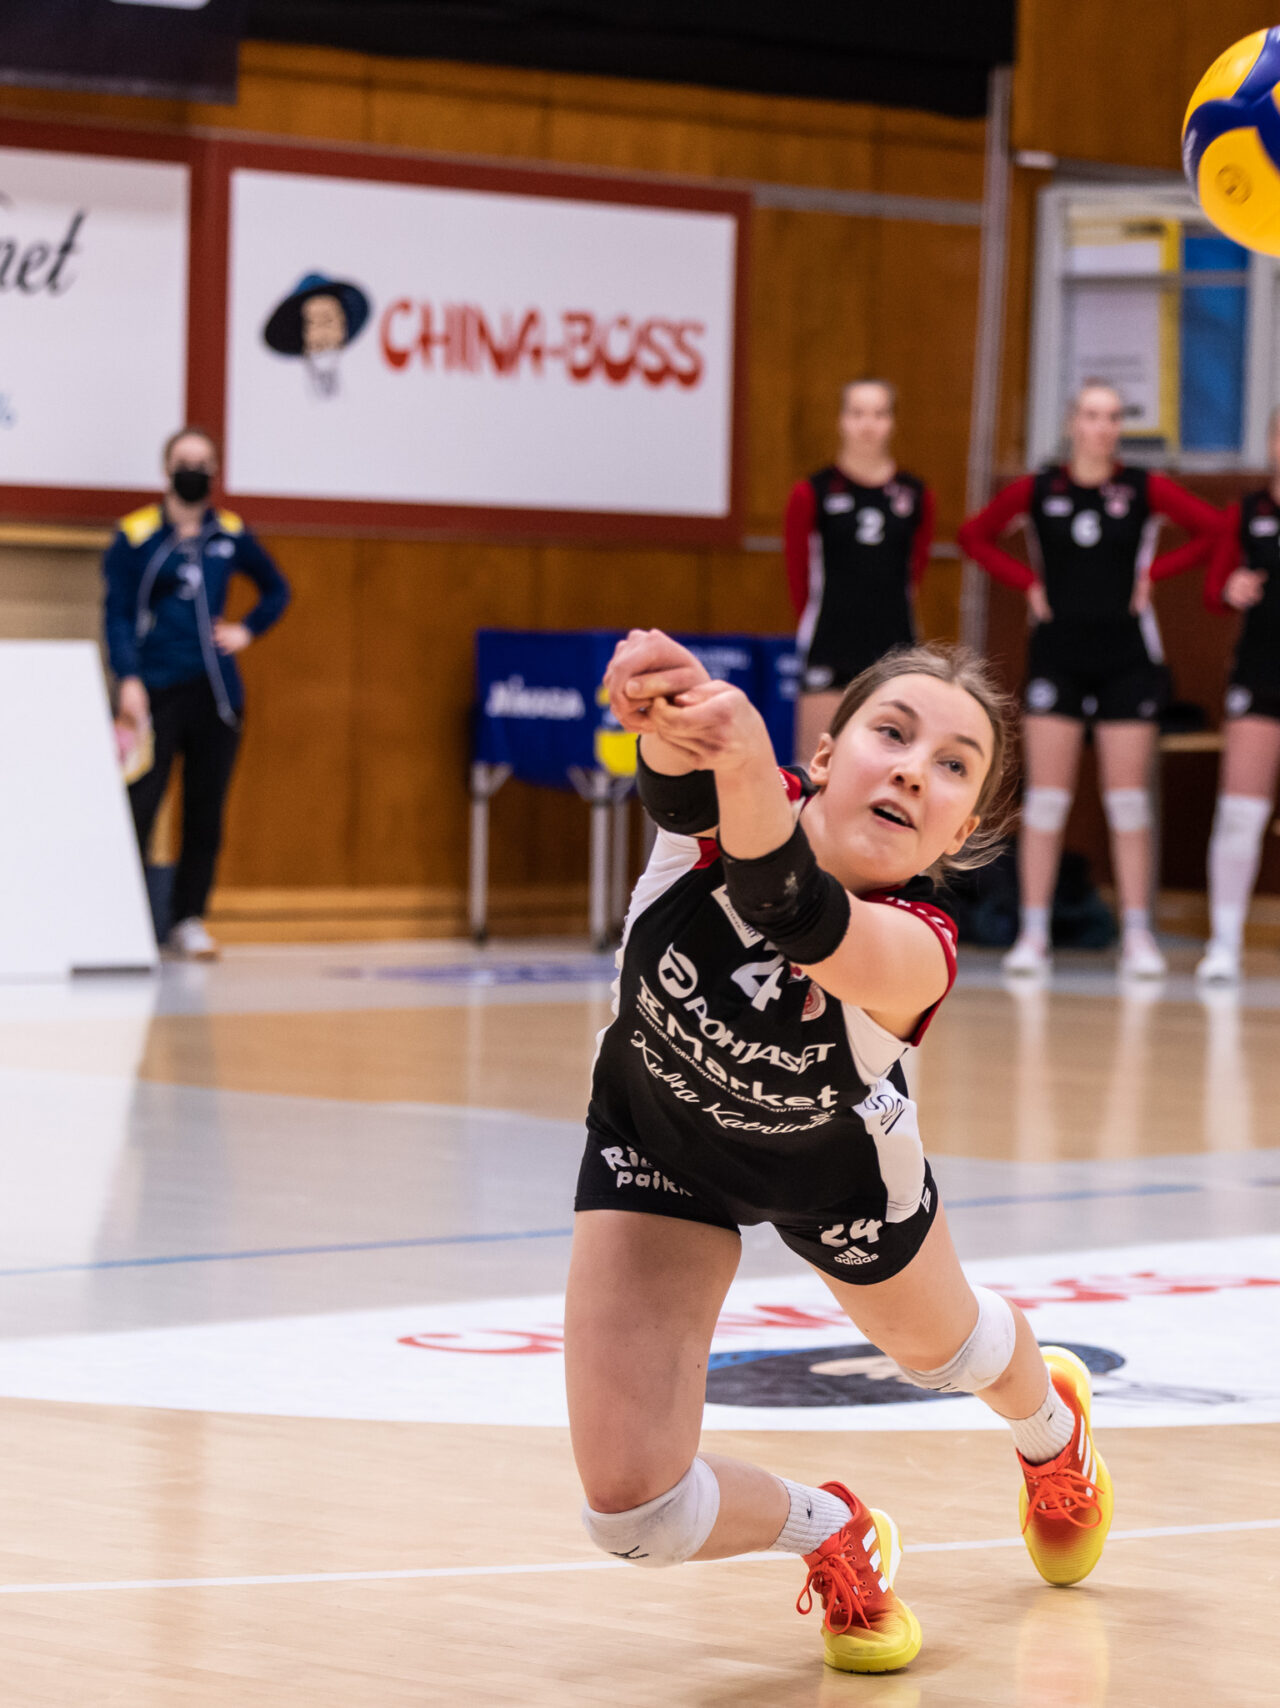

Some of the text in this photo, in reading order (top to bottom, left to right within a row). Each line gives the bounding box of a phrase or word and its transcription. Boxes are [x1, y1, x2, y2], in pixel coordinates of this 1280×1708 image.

[379, 299, 705, 390] CHINA-BOSS
[855, 506, 885, 545] 2
[1070, 508, 1102, 547] 6
[730, 940, 784, 1012] 4
[683, 996, 837, 1075] POHJASET
[819, 1218, 884, 1248] 24
[834, 1253, 880, 1266] adidas
